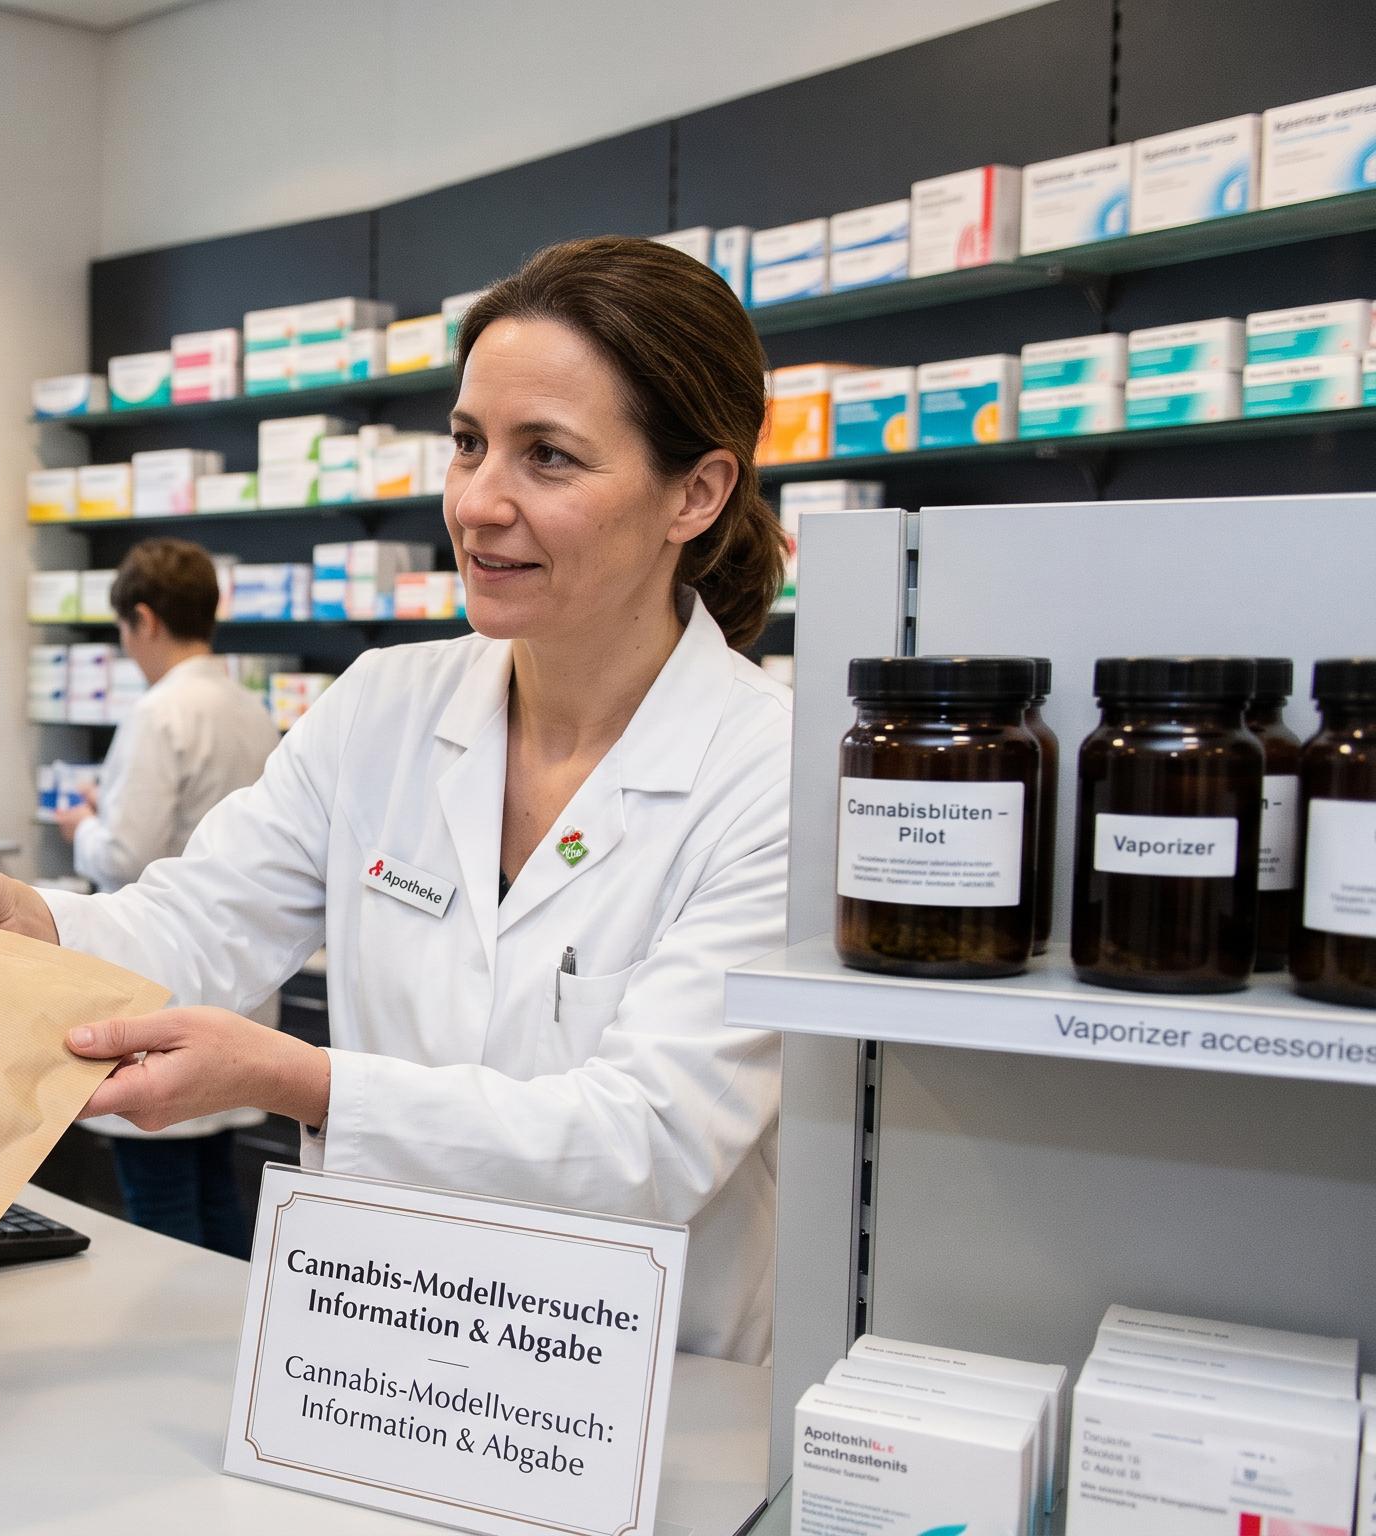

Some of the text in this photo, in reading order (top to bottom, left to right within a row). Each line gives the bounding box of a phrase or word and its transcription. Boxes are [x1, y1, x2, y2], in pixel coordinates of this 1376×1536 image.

[847, 800, 992, 820] Cannabisblüten
[898, 827, 945, 845] Pilot
[1113, 835, 1215, 857] Vaporizer
[383, 870, 442, 904] Apotheke
[1055, 1014, 1376, 1064] Vaporizer accessories
[286, 1248, 639, 1332] Cannabis-Modellversuche:
[308, 1288, 603, 1365] Information & Abgabe
[284, 1355, 614, 1443] Cannabis-Modellversuch:
[301, 1394, 585, 1477] Information & Abgabe
